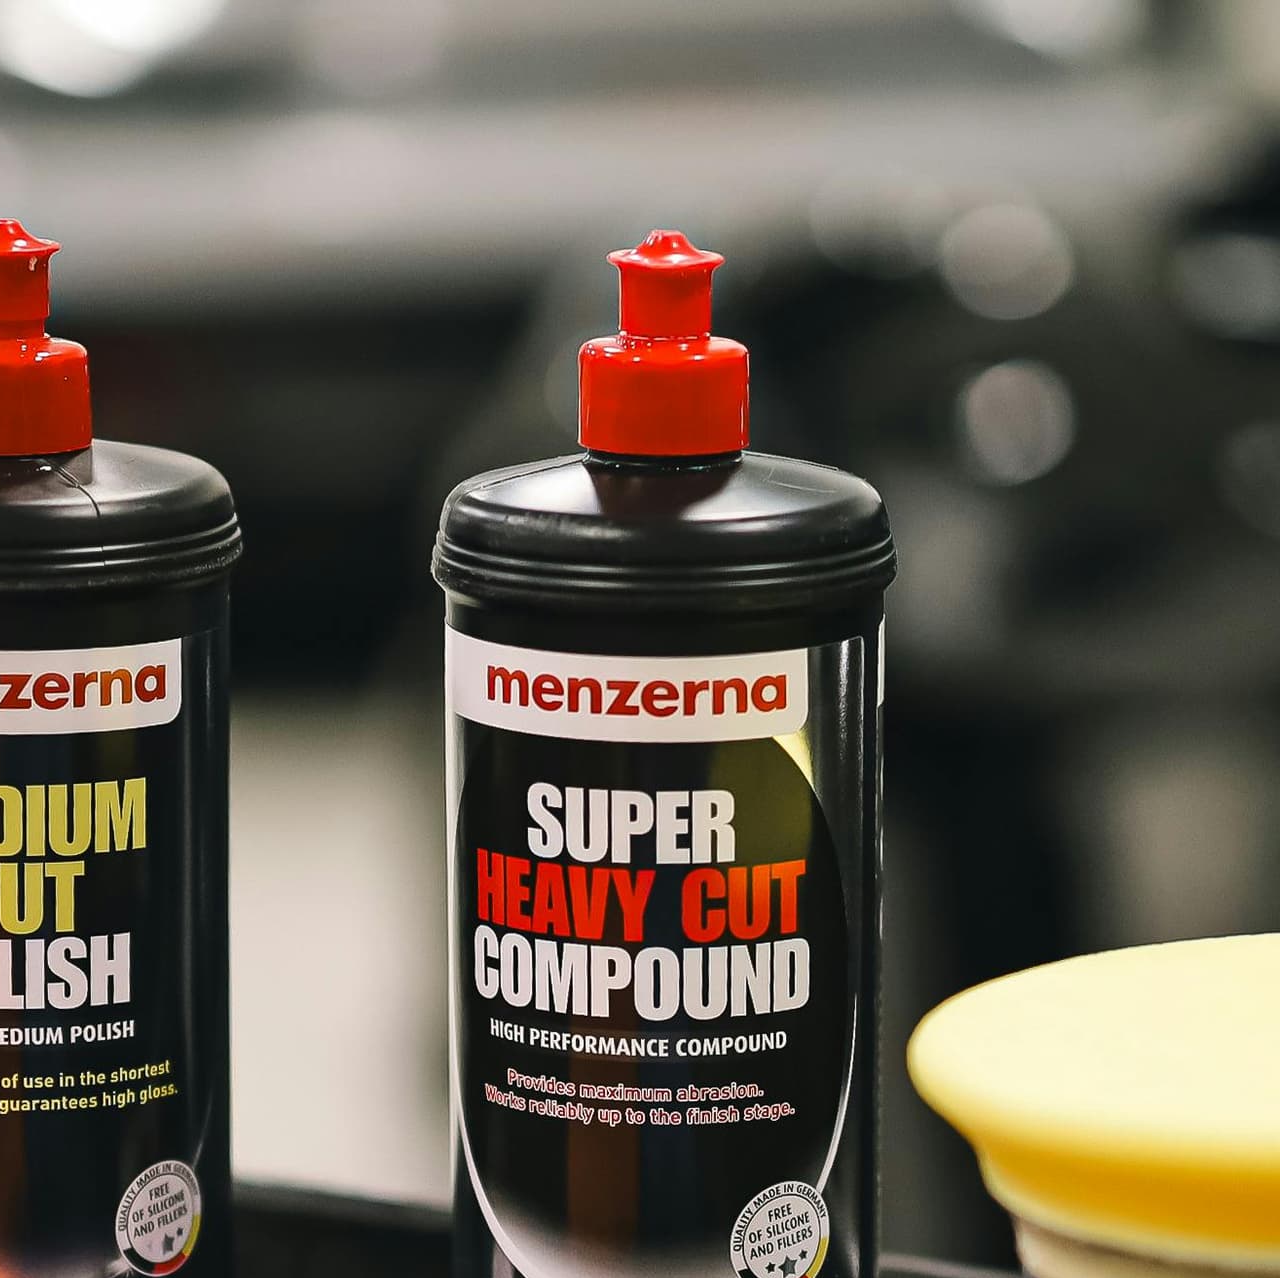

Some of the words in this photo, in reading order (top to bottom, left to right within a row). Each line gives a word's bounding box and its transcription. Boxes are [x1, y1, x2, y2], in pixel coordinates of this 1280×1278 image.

[487, 664, 787, 717] menzerna
[527, 781, 736, 864] SUPER
[476, 848, 656, 942] HEAVY
[681, 859, 807, 943] CUT
[474, 924, 810, 1021] COMPOUND
[70, 1019, 135, 1043] POLISH
[490, 1018, 525, 1044] HIGH
[529, 1028, 669, 1057] PERFORMANCE
[675, 1030, 788, 1057] COMPOUND
[1, 1073, 19, 1089] of
[23, 1074, 54, 1088] use
[59, 1072, 75, 1088] in
[79, 1071, 106, 1086] the
[110, 1059, 170, 1083] shortest
[507, 1068, 575, 1096] Provides
[579, 1083, 672, 1102] maximum
[676, 1082, 765, 1102] abrasion.
[102, 1090, 136, 1109] high
[139, 1082, 179, 1105] gloss.
[484, 1083, 526, 1111] Works
[528, 1098, 595, 1125] reliably
[598, 1108, 622, 1127] up
[625, 1106, 646, 1125] to
[649, 1107, 682, 1126] the
[686, 1105, 740, 1125] finish
[743, 1101, 795, 1122] stage.
[118, 1187, 137, 1231] QUALITY
[136, 1167, 161, 1188] MADE
[162, 1163, 172, 1173] IN
[132, 1209, 145, 1223] OF
[147, 1189, 185, 1218] SILICONE
[149, 1182, 169, 1201] FREE
[133, 1221, 155, 1238] AND
[157, 1204, 188, 1228] FILLERS
[733, 1207, 753, 1252] QUALITY
[753, 1186, 781, 1209] MADE
[783, 1184, 794, 1193] IN
[796, 1184, 827, 1218] GERMANY
[748, 1229, 762, 1244] OF
[766, 1211, 810, 1239] SILICONE
[768, 1203, 793, 1223] FREE
[750, 1242, 774, 1260] AND
[777, 1226, 813, 1250] FILLERS
